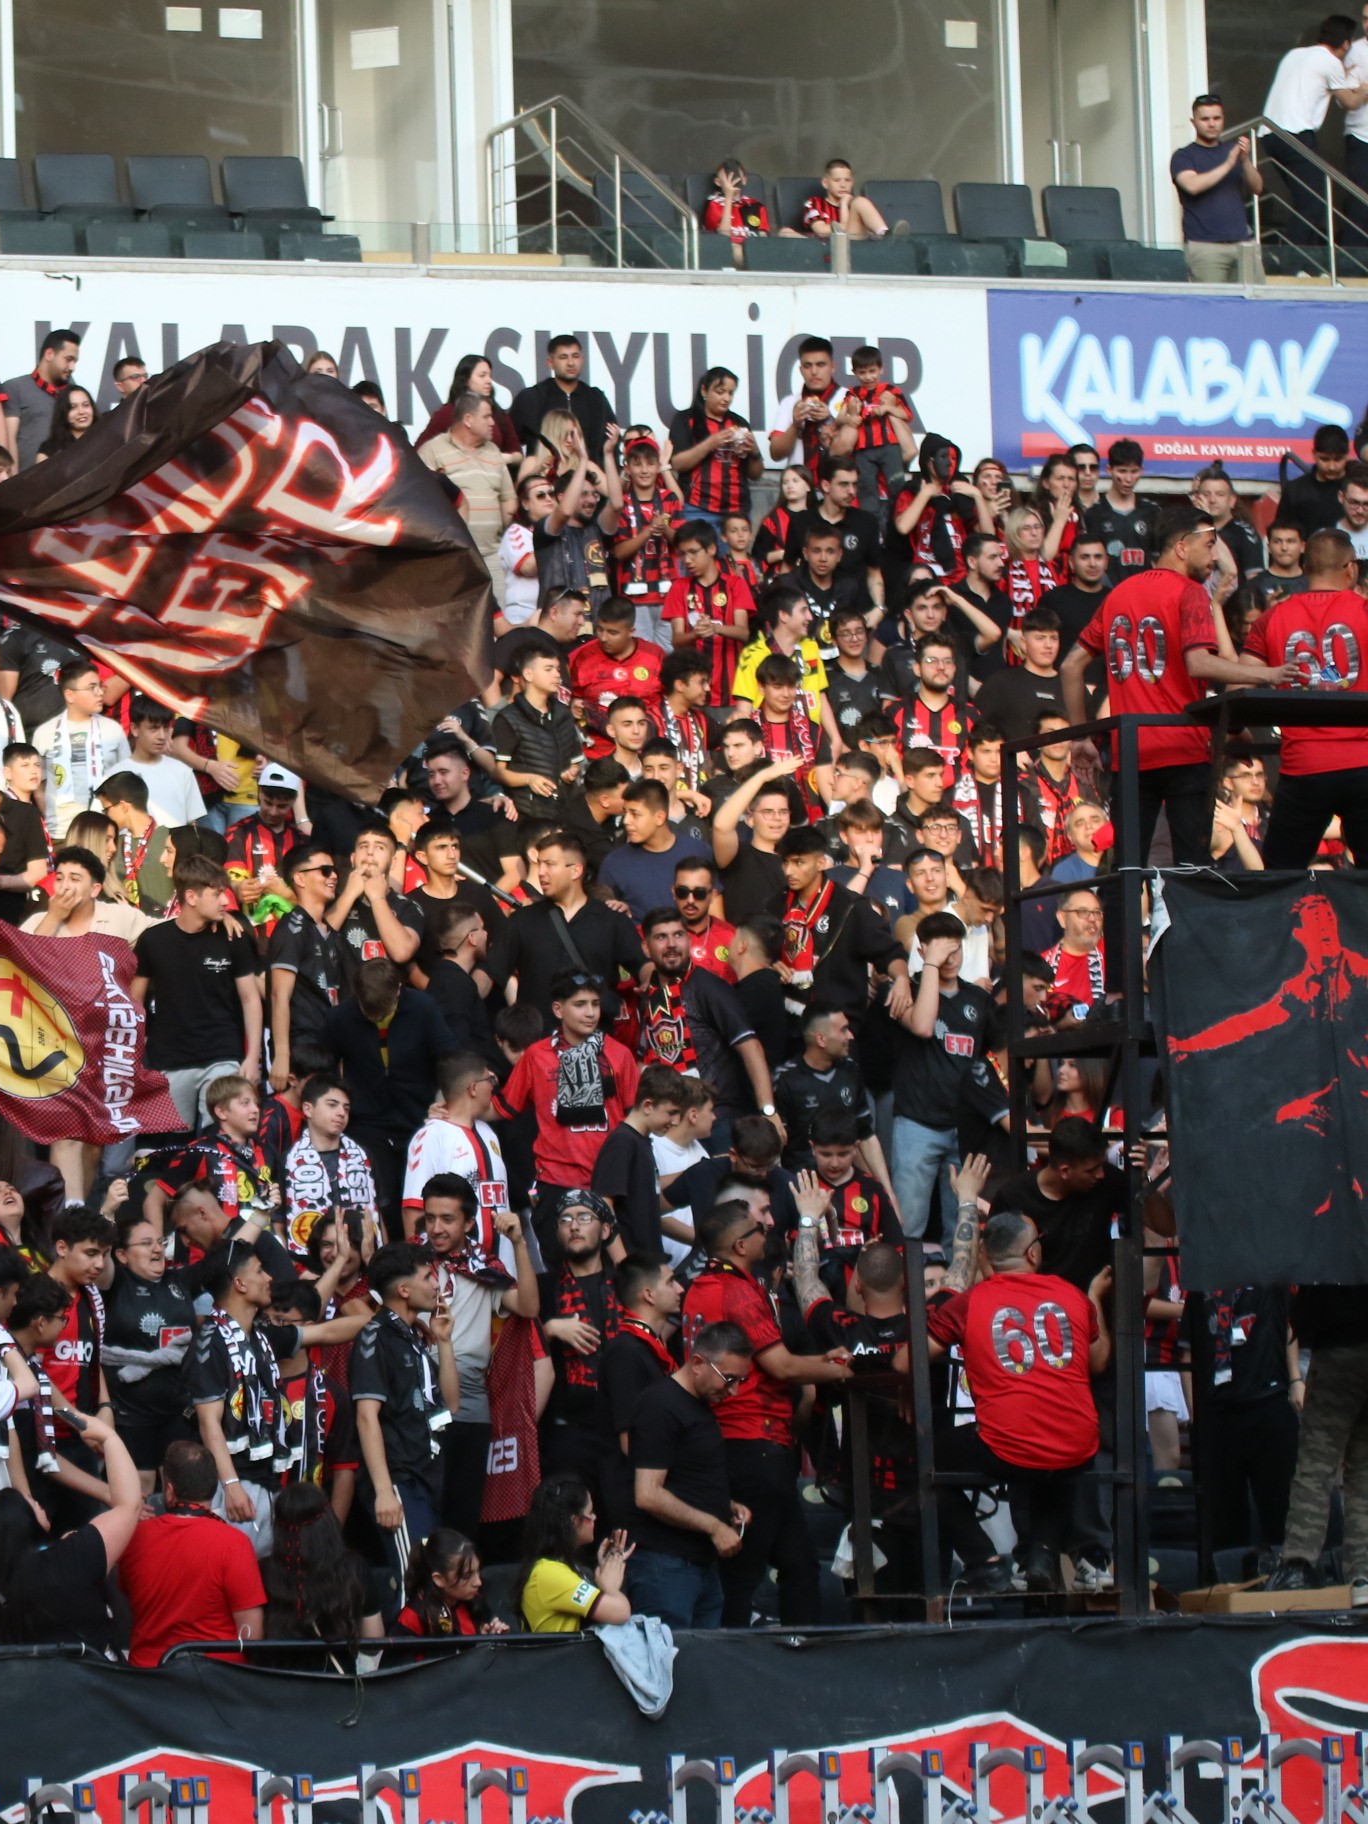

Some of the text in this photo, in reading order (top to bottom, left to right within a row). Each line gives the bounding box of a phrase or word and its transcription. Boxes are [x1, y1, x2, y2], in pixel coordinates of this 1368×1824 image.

[1020, 316, 1352, 448] KALABAK
[1154, 442, 1195, 457] DOĞAL
[1199, 444, 1254, 457] KAYNAK
[1108, 615, 1167, 685] 60
[991, 1301, 1073, 1375] 60
